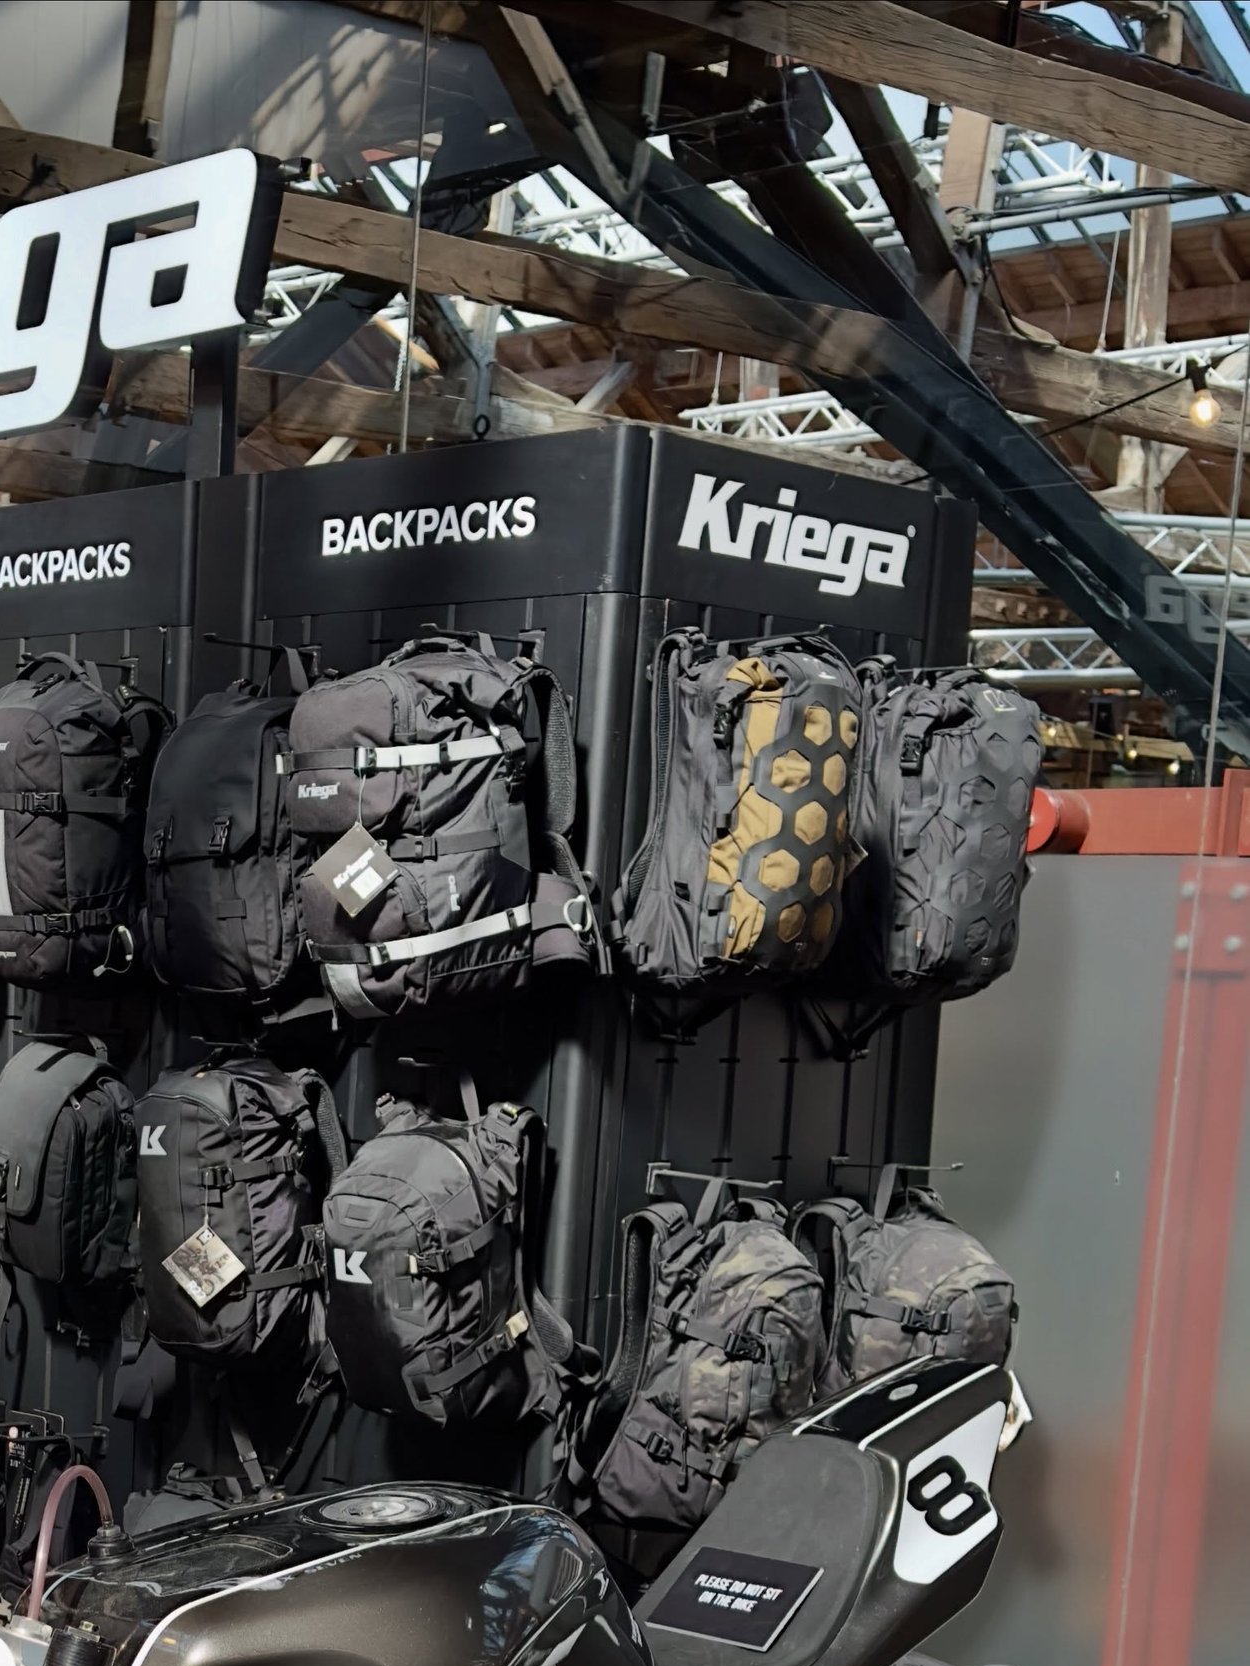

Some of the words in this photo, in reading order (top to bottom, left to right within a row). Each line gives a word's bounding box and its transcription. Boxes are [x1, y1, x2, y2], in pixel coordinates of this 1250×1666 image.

[322, 496, 536, 557] BACKPACKS
[678, 473, 916, 596] Kriega
[298, 783, 340, 799] Kriega
[907, 1455, 991, 1536] 8
[694, 1574, 733, 1590] PLEASE
[728, 1580, 746, 1593] DO
[742, 1583, 766, 1597] NOT
[762, 1587, 783, 1600] SIT
